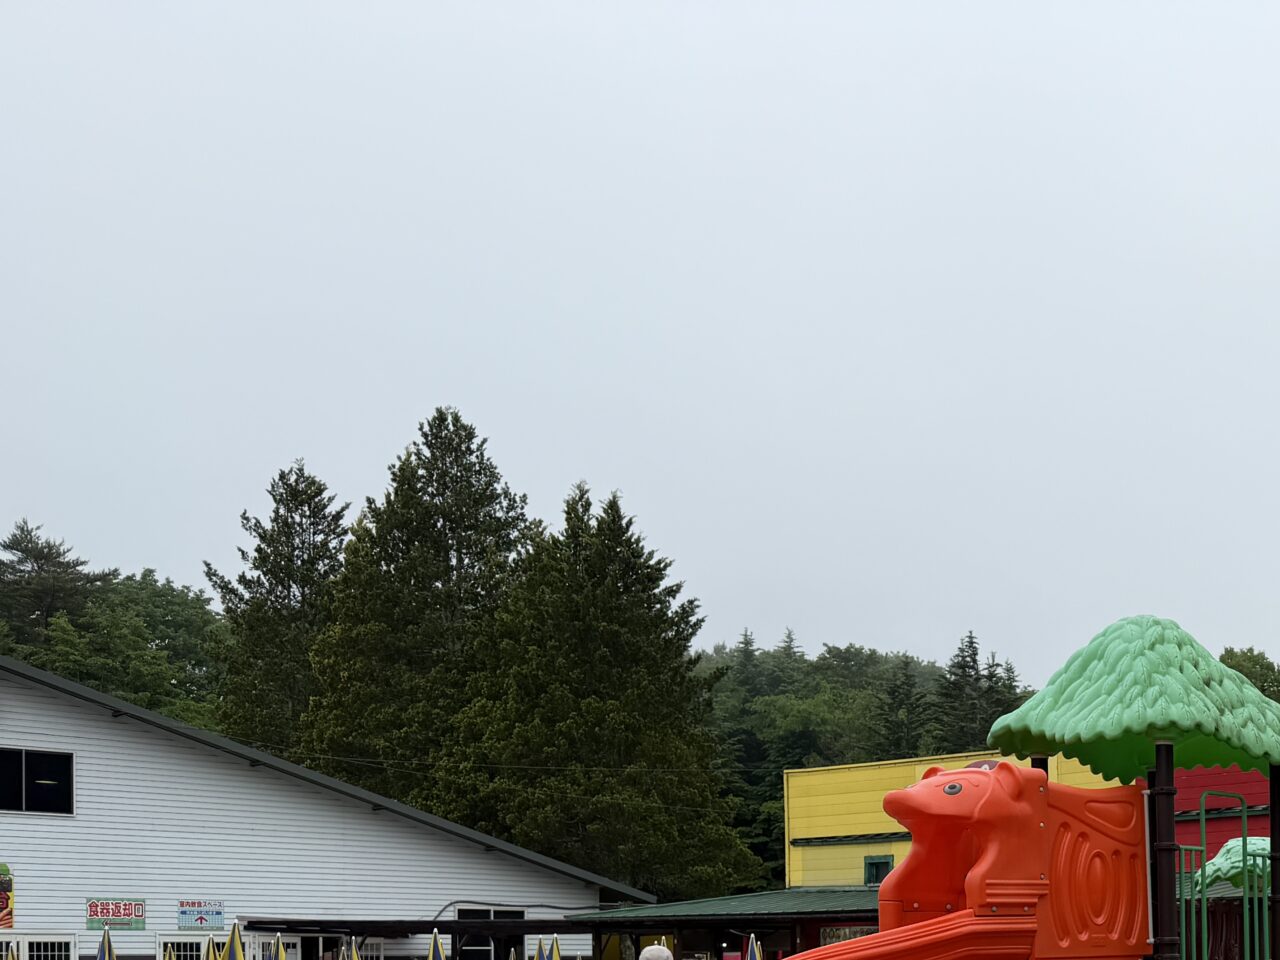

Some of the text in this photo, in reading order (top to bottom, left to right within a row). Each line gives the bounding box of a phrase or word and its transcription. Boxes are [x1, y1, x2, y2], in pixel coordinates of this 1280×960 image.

[88, 901, 144, 918] 食器返却口
